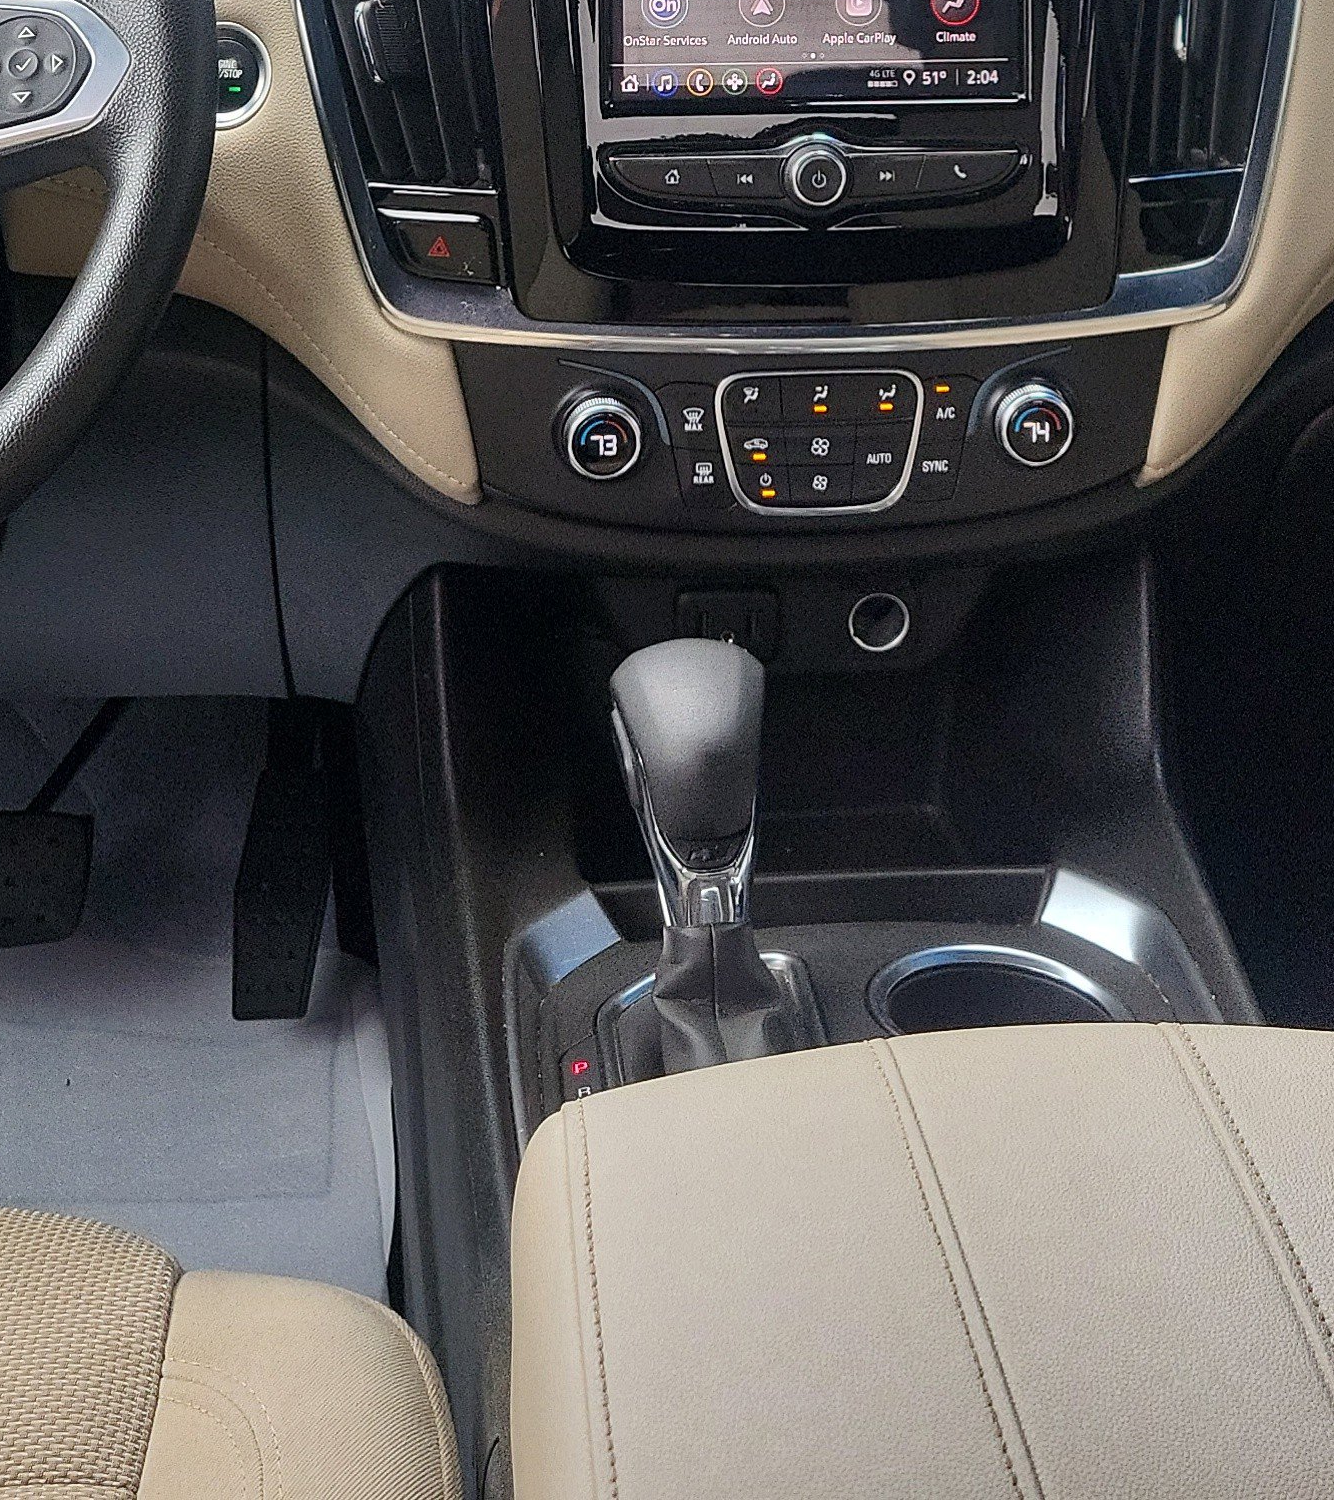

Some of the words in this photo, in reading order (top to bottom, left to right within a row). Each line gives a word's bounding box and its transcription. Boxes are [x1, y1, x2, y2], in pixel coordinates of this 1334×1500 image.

[623, 35, 661, 46] OnStar
[663, 35, 708, 46] Services
[727, 34, 770, 45] Android
[772, 34, 798, 45] Auto
[822, 33, 854, 46] Apple
[856, 32, 897, 45] CarPlay
[936, 31, 977, 43] Climate
[869, 69, 881, 78] 4G
[882, 69, 896, 78] LTE
[966, 70, 999, 85] 2:04
[936, 407, 956, 419] A/C
[684, 423, 703, 431] MAX
[1023, 421, 1050, 443] 74
[590, 434, 617, 456] 73
[867, 453, 892, 464] AUTO
[922, 461, 949, 472] SYNC
[693, 475, 714, 484] REAR
[573, 1061, 588, 1074] P
[578, 1086, 591, 1097] R
